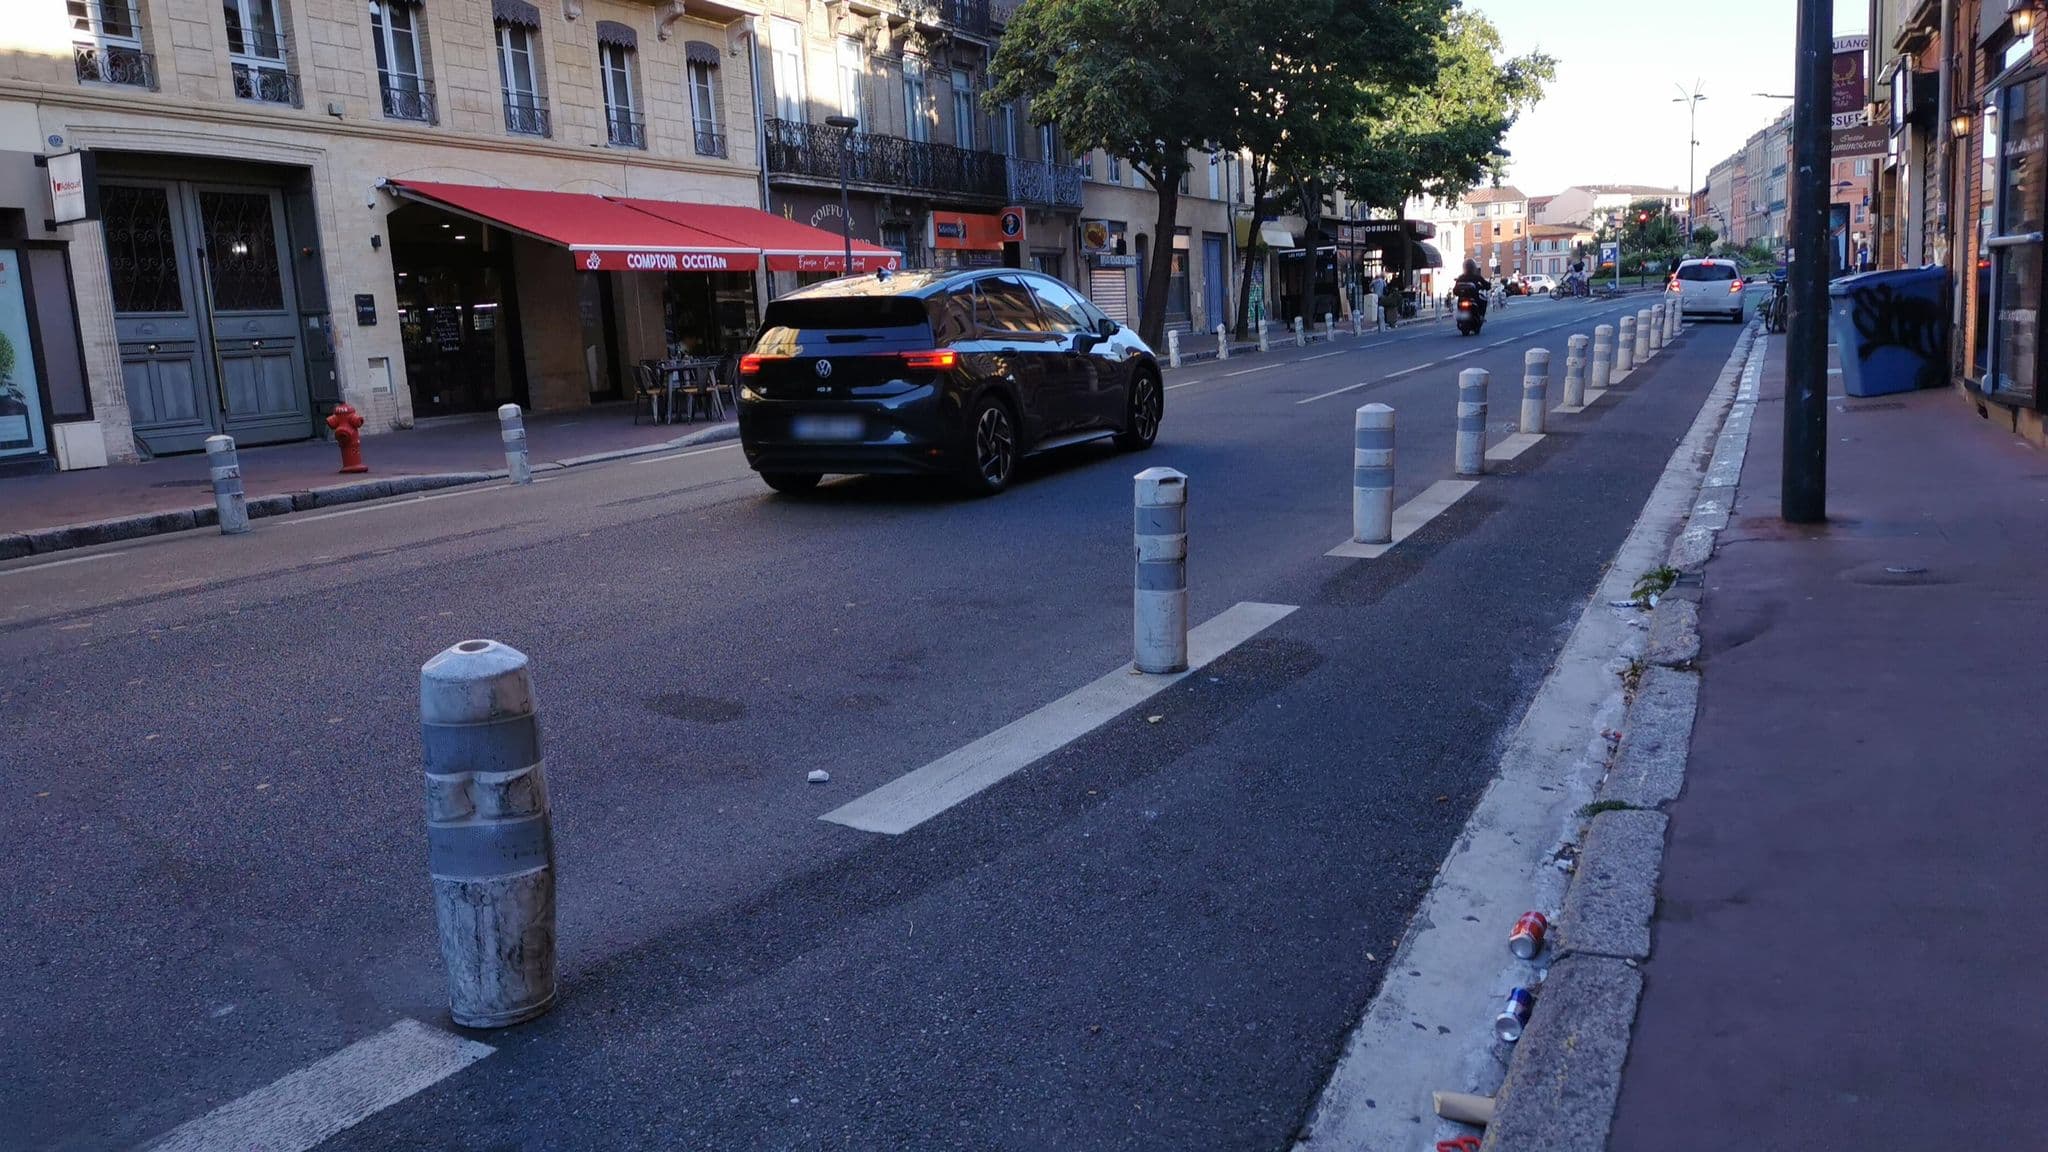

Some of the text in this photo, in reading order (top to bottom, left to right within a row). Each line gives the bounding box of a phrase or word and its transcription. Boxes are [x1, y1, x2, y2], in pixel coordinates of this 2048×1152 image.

[1833, 38, 1868, 50] ULANG
[627, 253, 727, 269] COMPTOIR OCCITAN
